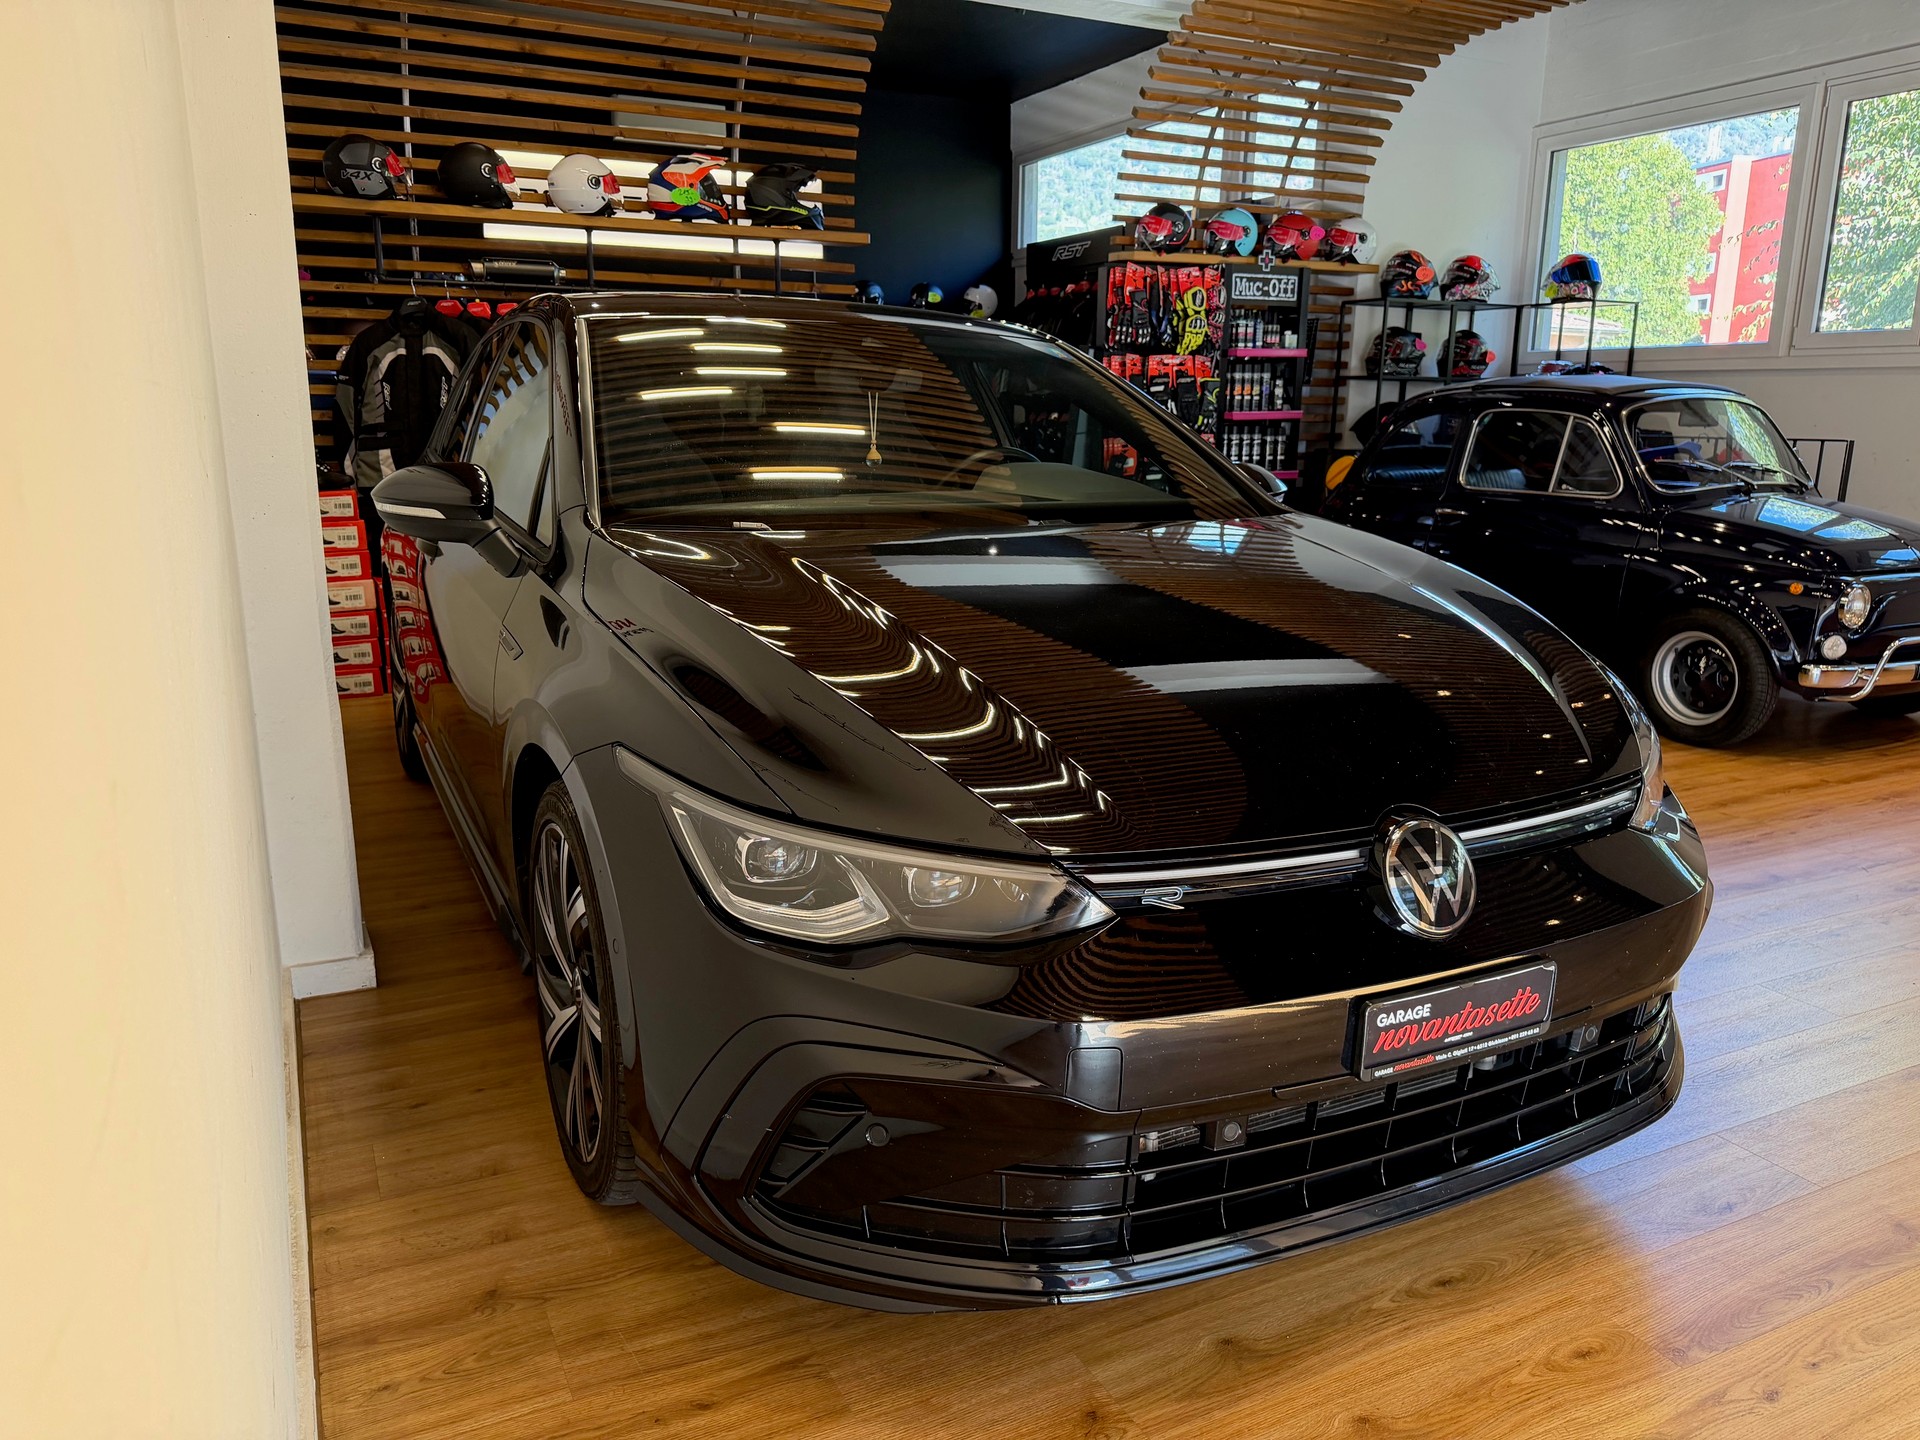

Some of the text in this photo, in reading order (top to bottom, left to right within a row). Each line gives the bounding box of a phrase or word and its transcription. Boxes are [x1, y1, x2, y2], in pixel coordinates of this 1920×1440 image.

[341, 170, 374, 181] V4X
[1052, 240, 1092, 261] RST
[1234, 277, 1295, 297] Muc-Off
[1141, 886, 1185, 909] R
[1372, 986, 1542, 1054] novantasette
[1376, 1003, 1432, 1028] GARAGE
[1374, 1067, 1394, 1077] GARAGE
[1393, 1054, 1435, 1072] novantasette
